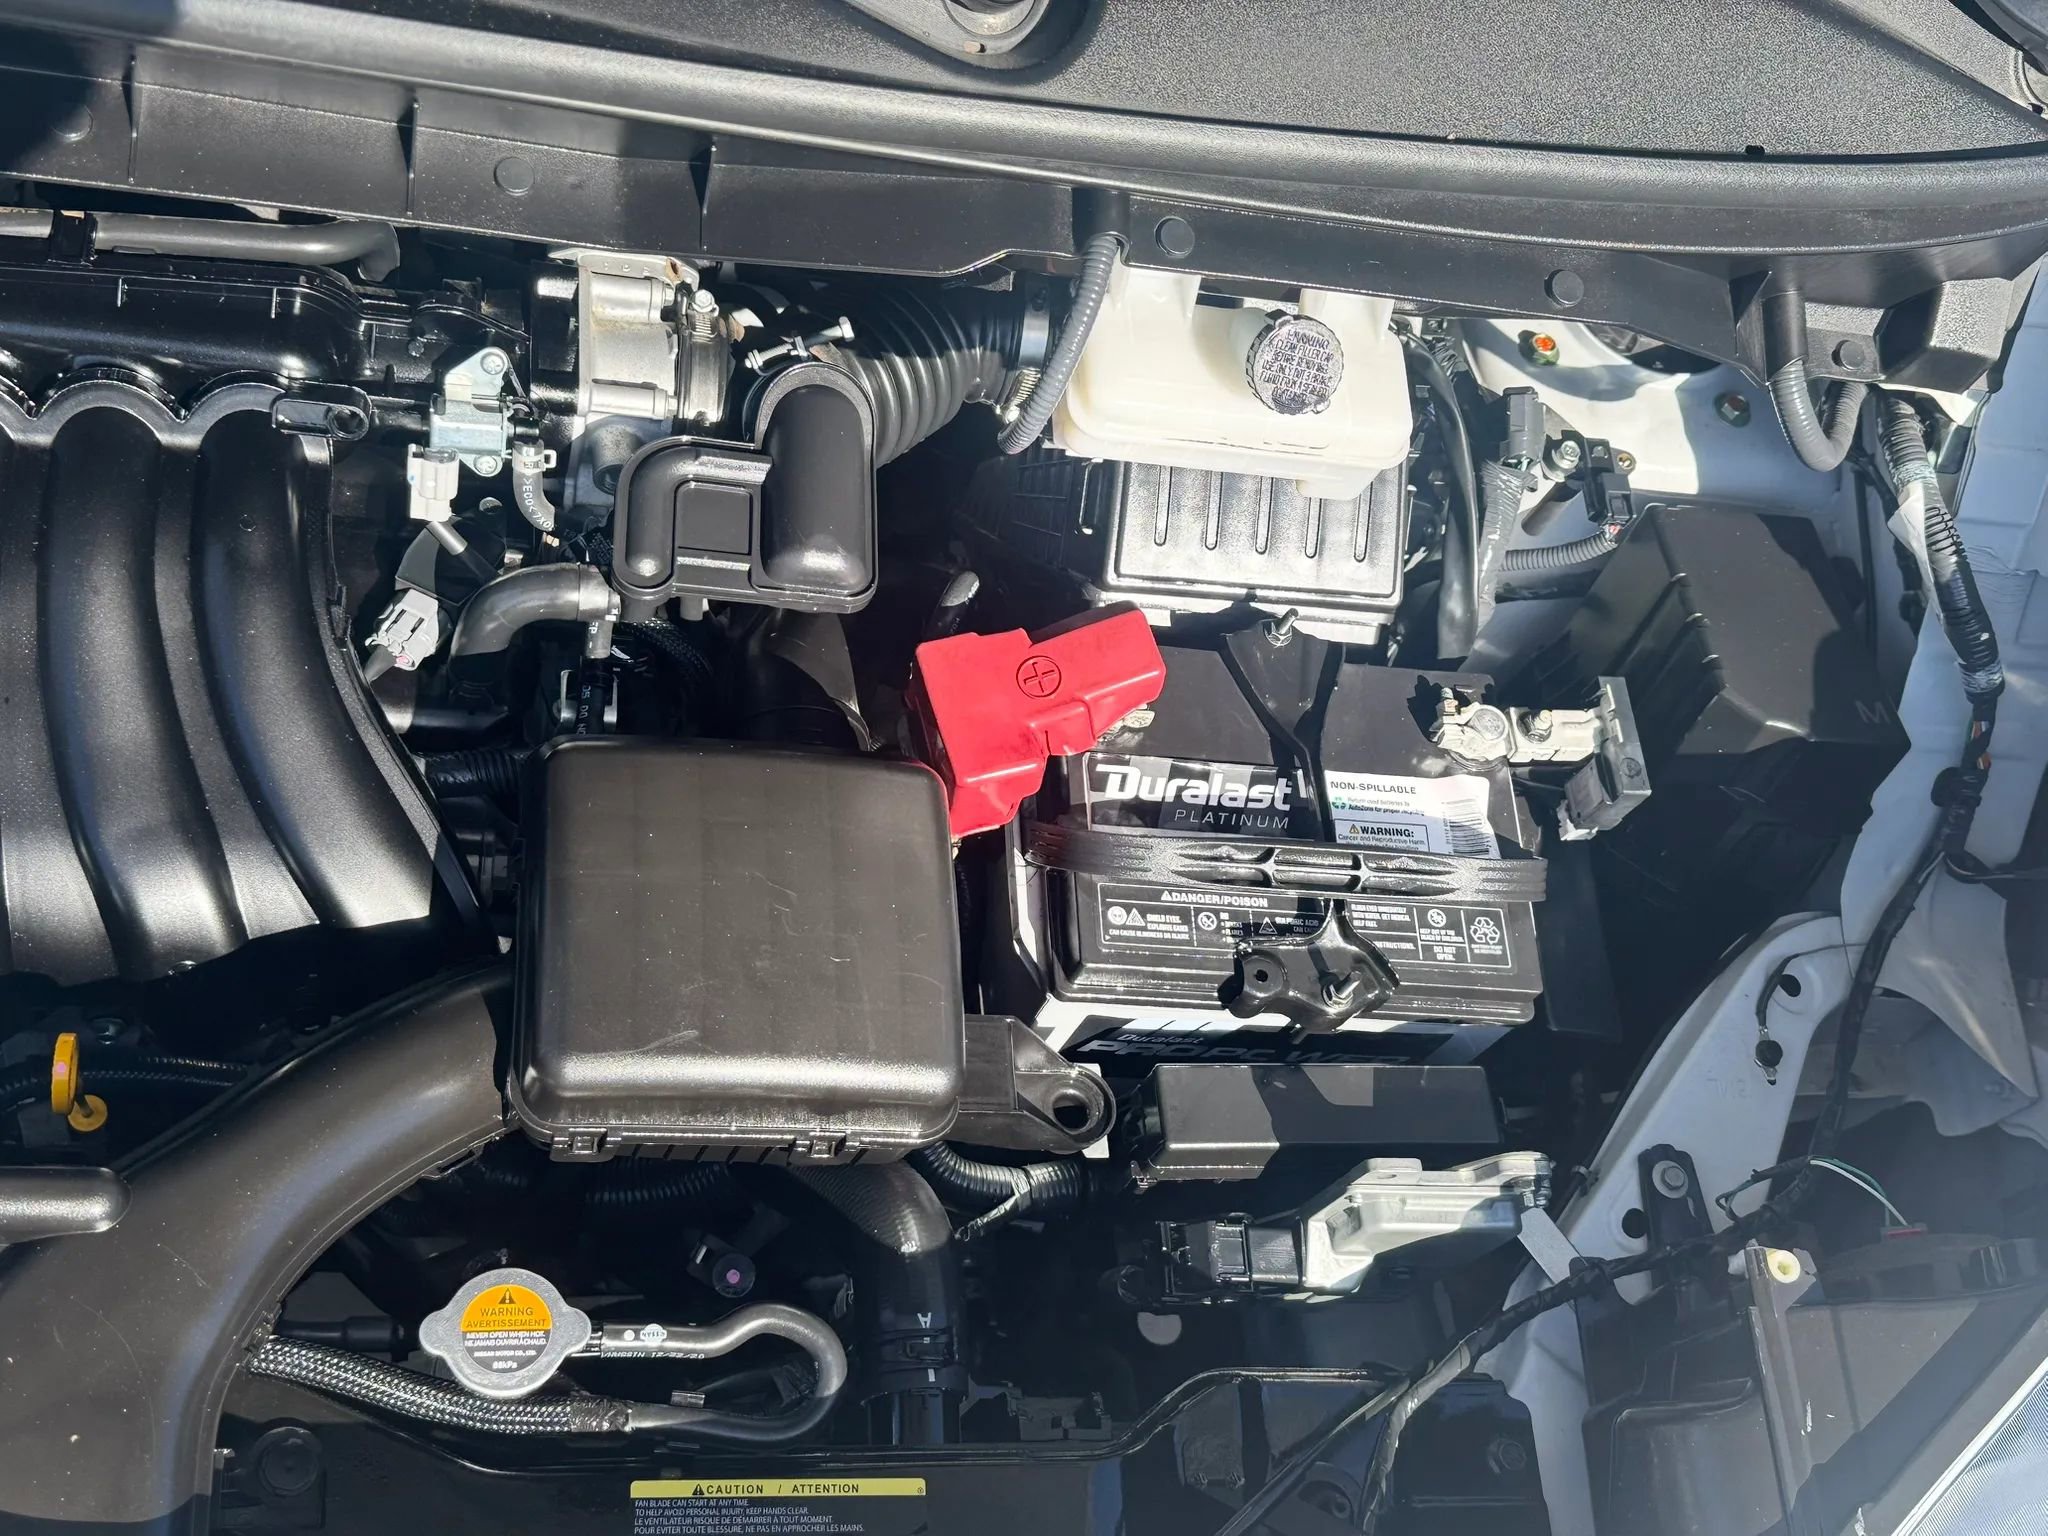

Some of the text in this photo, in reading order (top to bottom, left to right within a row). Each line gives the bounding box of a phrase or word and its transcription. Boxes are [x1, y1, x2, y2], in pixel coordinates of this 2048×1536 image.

[1095, 763, 1293, 812] Duralast
[1330, 781, 1417, 795] NON-SPILLABLE
[1174, 809, 1289, 830] PLATINUM
[1360, 825, 1414, 838] WARNING:
[1338, 833, 1358, 841] Cancer
[1372, 836, 1408, 845] Reproductive
[1116, 1033, 1205, 1045] Duralast
[480, 1306, 534, 1317] WARNING
[466, 1318, 547, 1328] AVERTISSEMENT
[466, 1331, 488, 1339] NEVER
[489, 1331, 508, 1339] OPEN
[508, 1330, 529, 1338] WHEN
[706, 1484, 763, 1495] CAUTION
[791, 1483, 859, 1494] ATTENTION
[650, 1499, 671, 1507] BLADE
[672, 1499, 688, 1507] CAN
[636, 1508, 645, 1516] TO
[645, 1508, 662, 1516] HELP
[663, 1508, 685, 1516] AVOID
[685, 1508, 720, 1516] PERSONAL
[745, 1507, 762, 1515] KEEP
[763, 1507, 786, 1515] HANDS
[635, 1517, 643, 1525] LE
[644, 1517, 692, 1525] VENTILATEUR
[693, 1517, 720, 1526] RISQUE
[721, 1516, 731, 1524] DE
[634, 1526, 655, 1534] POUR
[745, 1525, 754, 1533] NE
[756, 1525, 770, 1533] PAS
[782, 1524, 826, 1532] APPROCHER
[826, 1524, 839, 1532] LES
